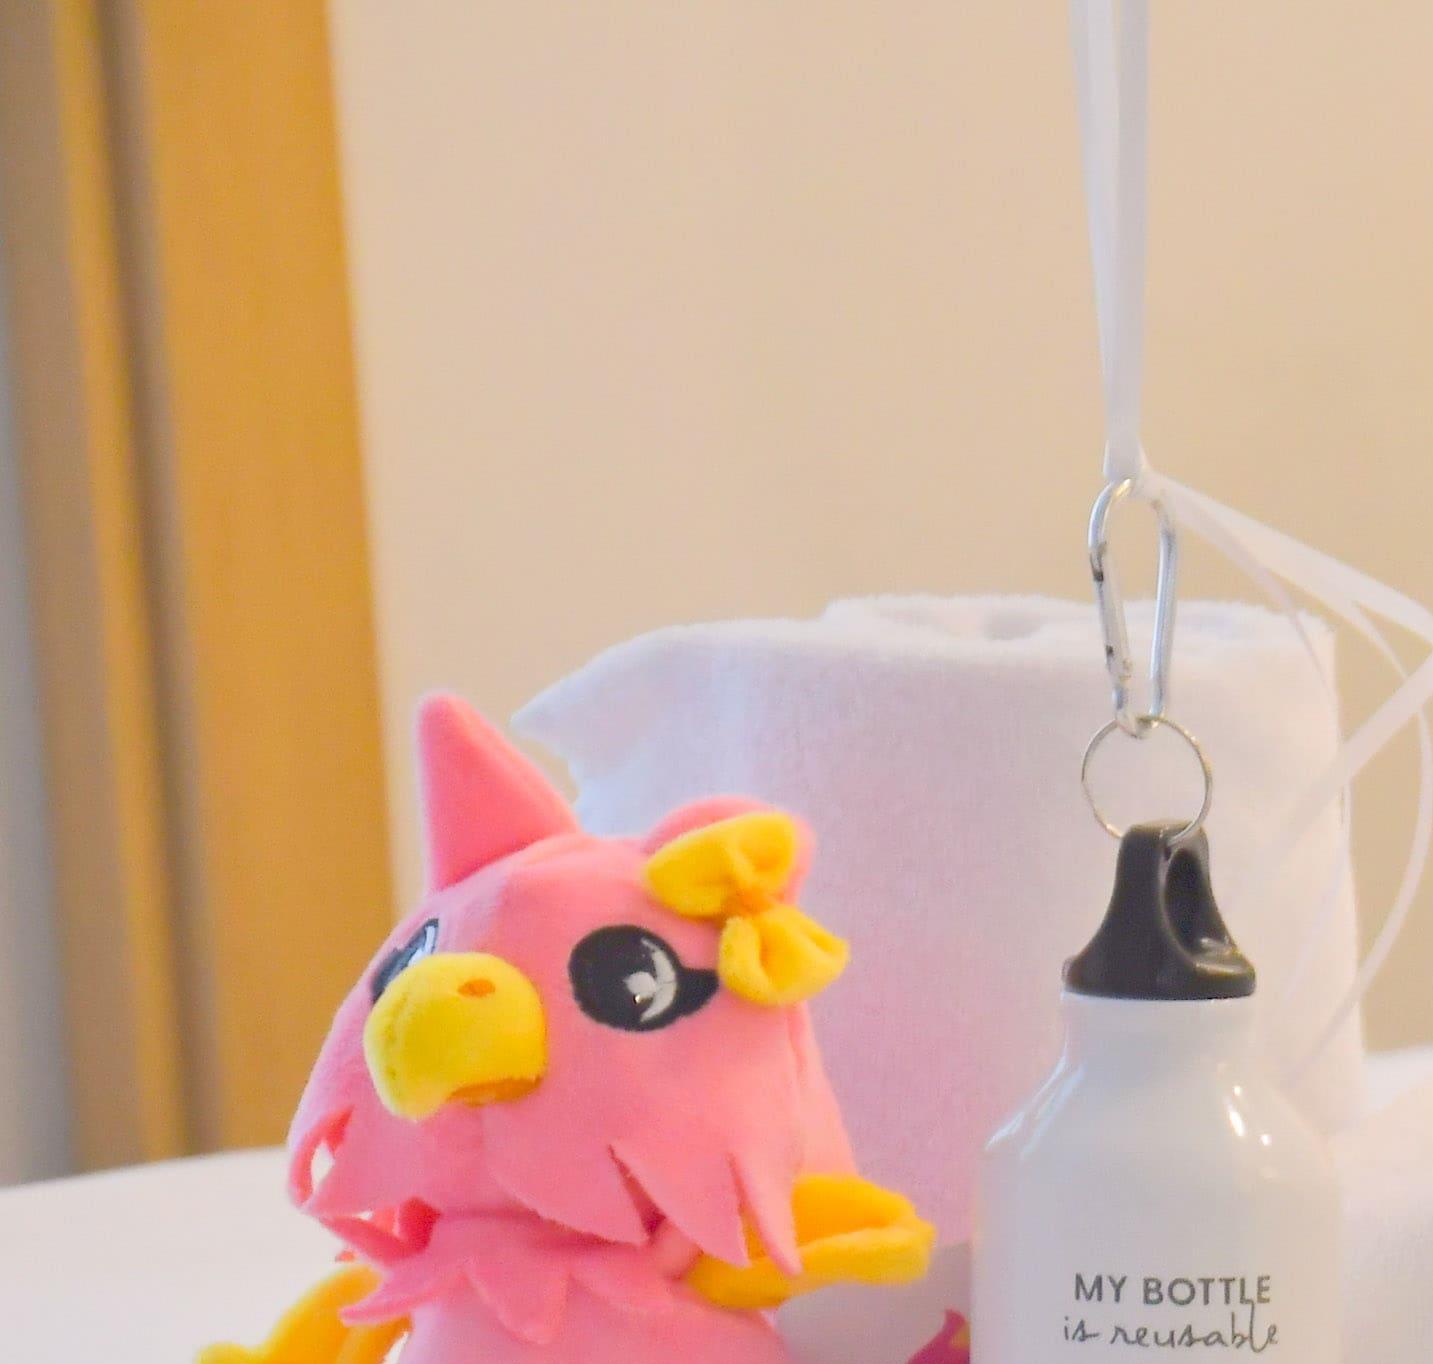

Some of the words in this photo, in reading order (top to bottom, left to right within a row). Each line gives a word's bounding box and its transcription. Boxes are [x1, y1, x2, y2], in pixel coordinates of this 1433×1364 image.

[1075, 1273, 1127, 1303] MY
[1143, 1276, 1270, 1306] BOTTLE
[1064, 1316, 1099, 1342] is
[1110, 1303, 1278, 1353] reusable
